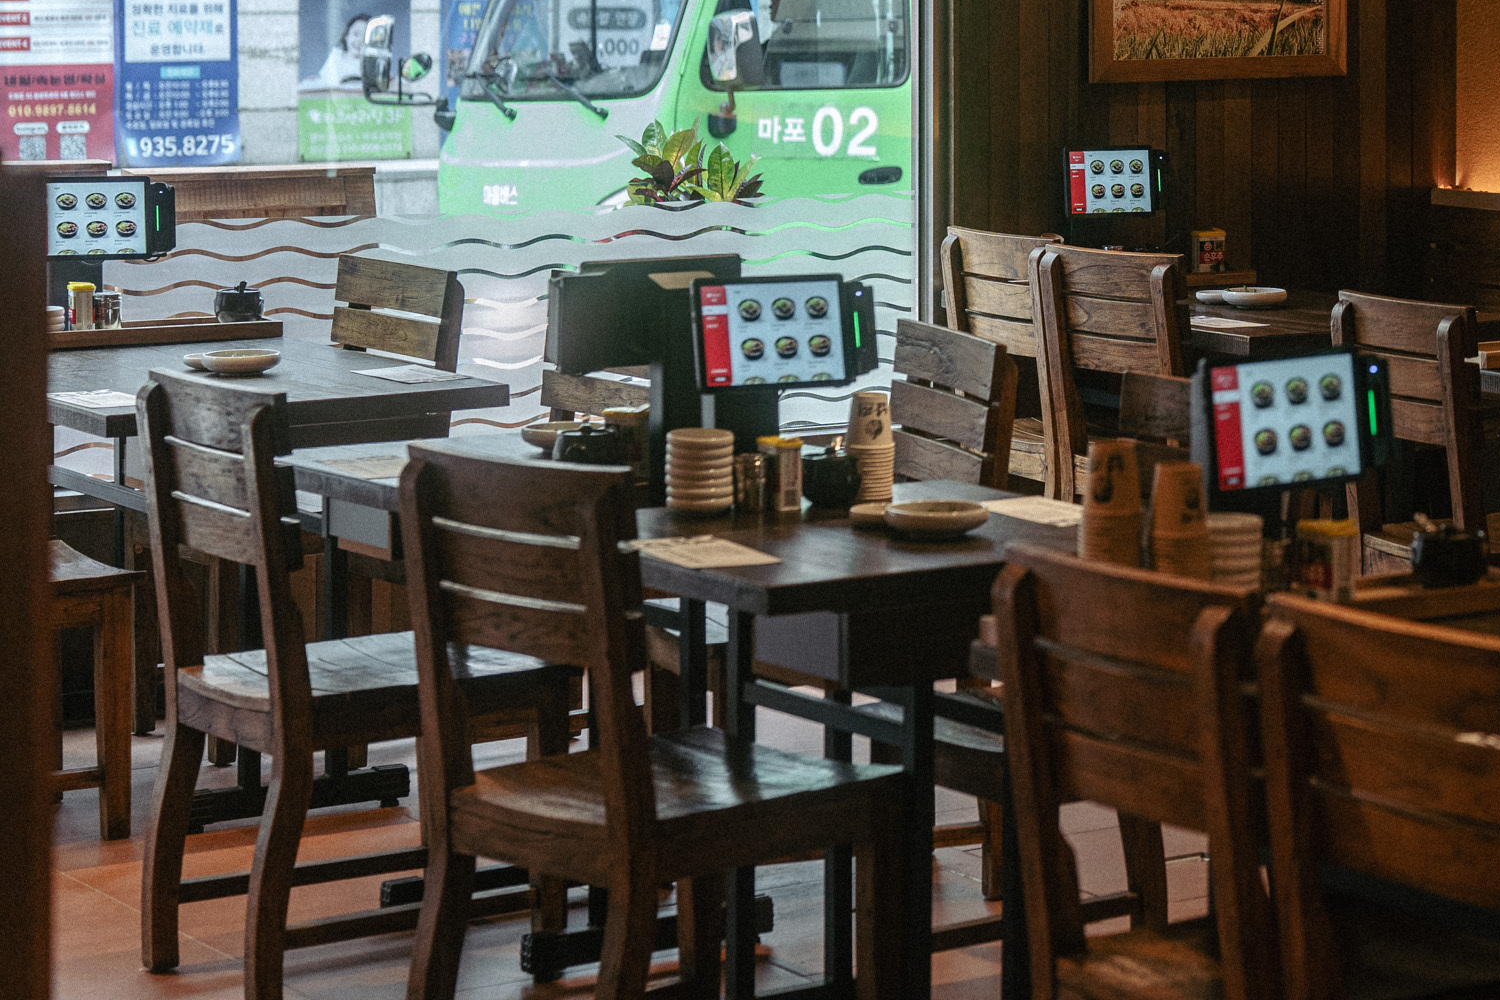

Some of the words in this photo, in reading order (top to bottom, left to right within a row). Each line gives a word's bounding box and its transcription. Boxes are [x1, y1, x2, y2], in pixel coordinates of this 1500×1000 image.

[140, 133, 235, 158] 935.8275
[758, 115, 806, 144] 마포
[812, 105, 879, 156] 02
